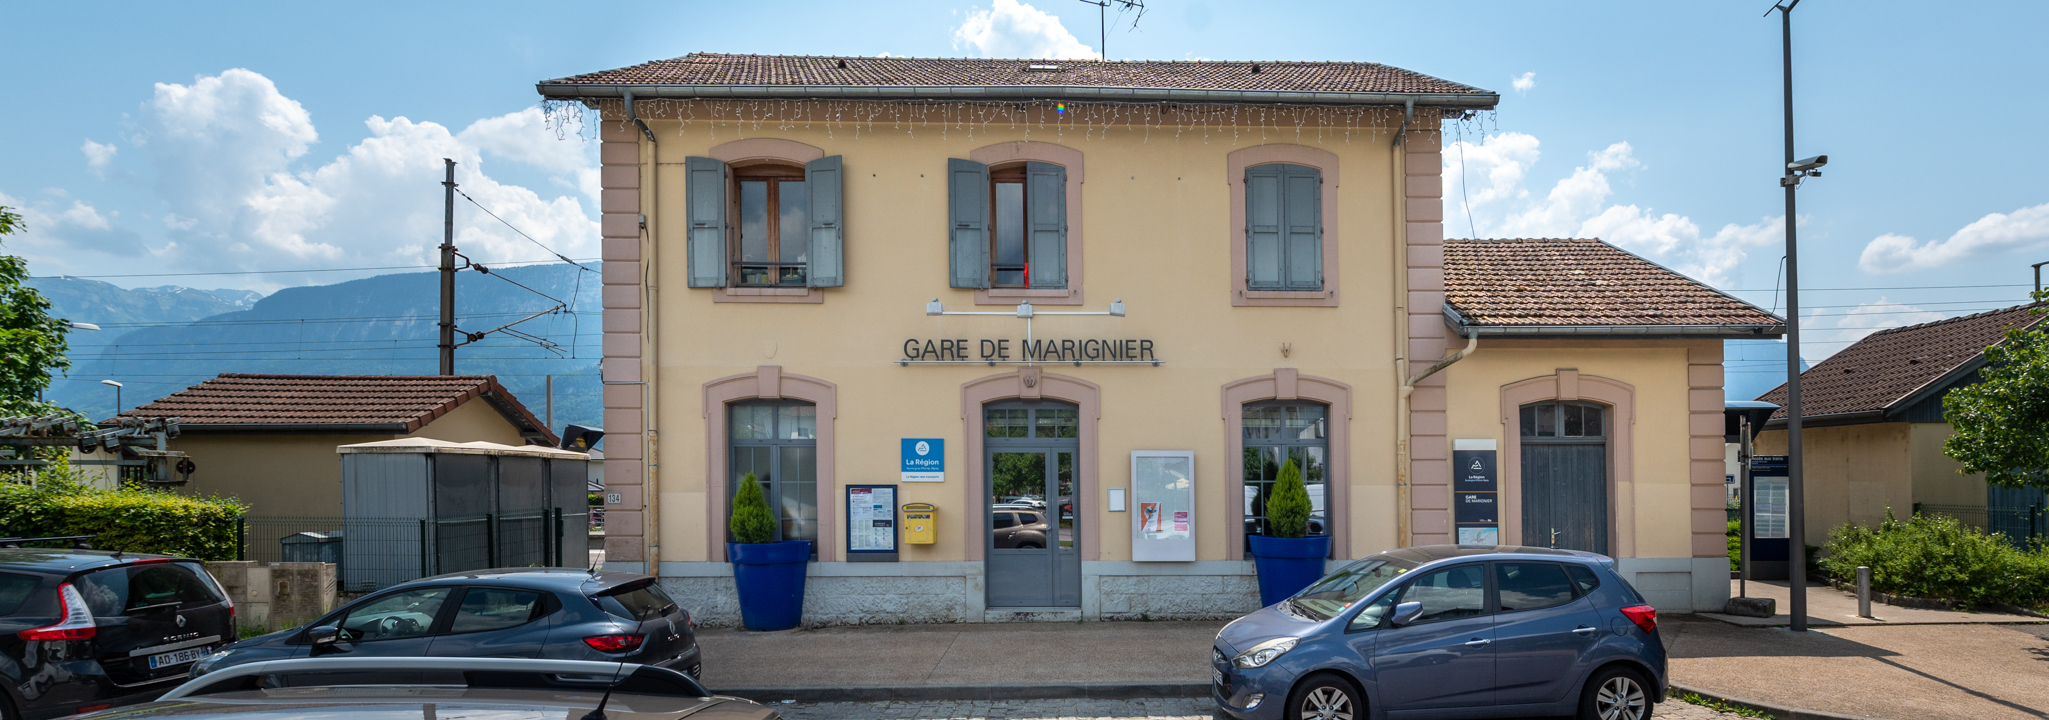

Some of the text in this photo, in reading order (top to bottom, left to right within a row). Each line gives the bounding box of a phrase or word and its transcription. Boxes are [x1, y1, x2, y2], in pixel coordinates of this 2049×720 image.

[903, 338, 1155, 360] GARE DE MARIGNIER
[609, 494, 619, 502] 134
